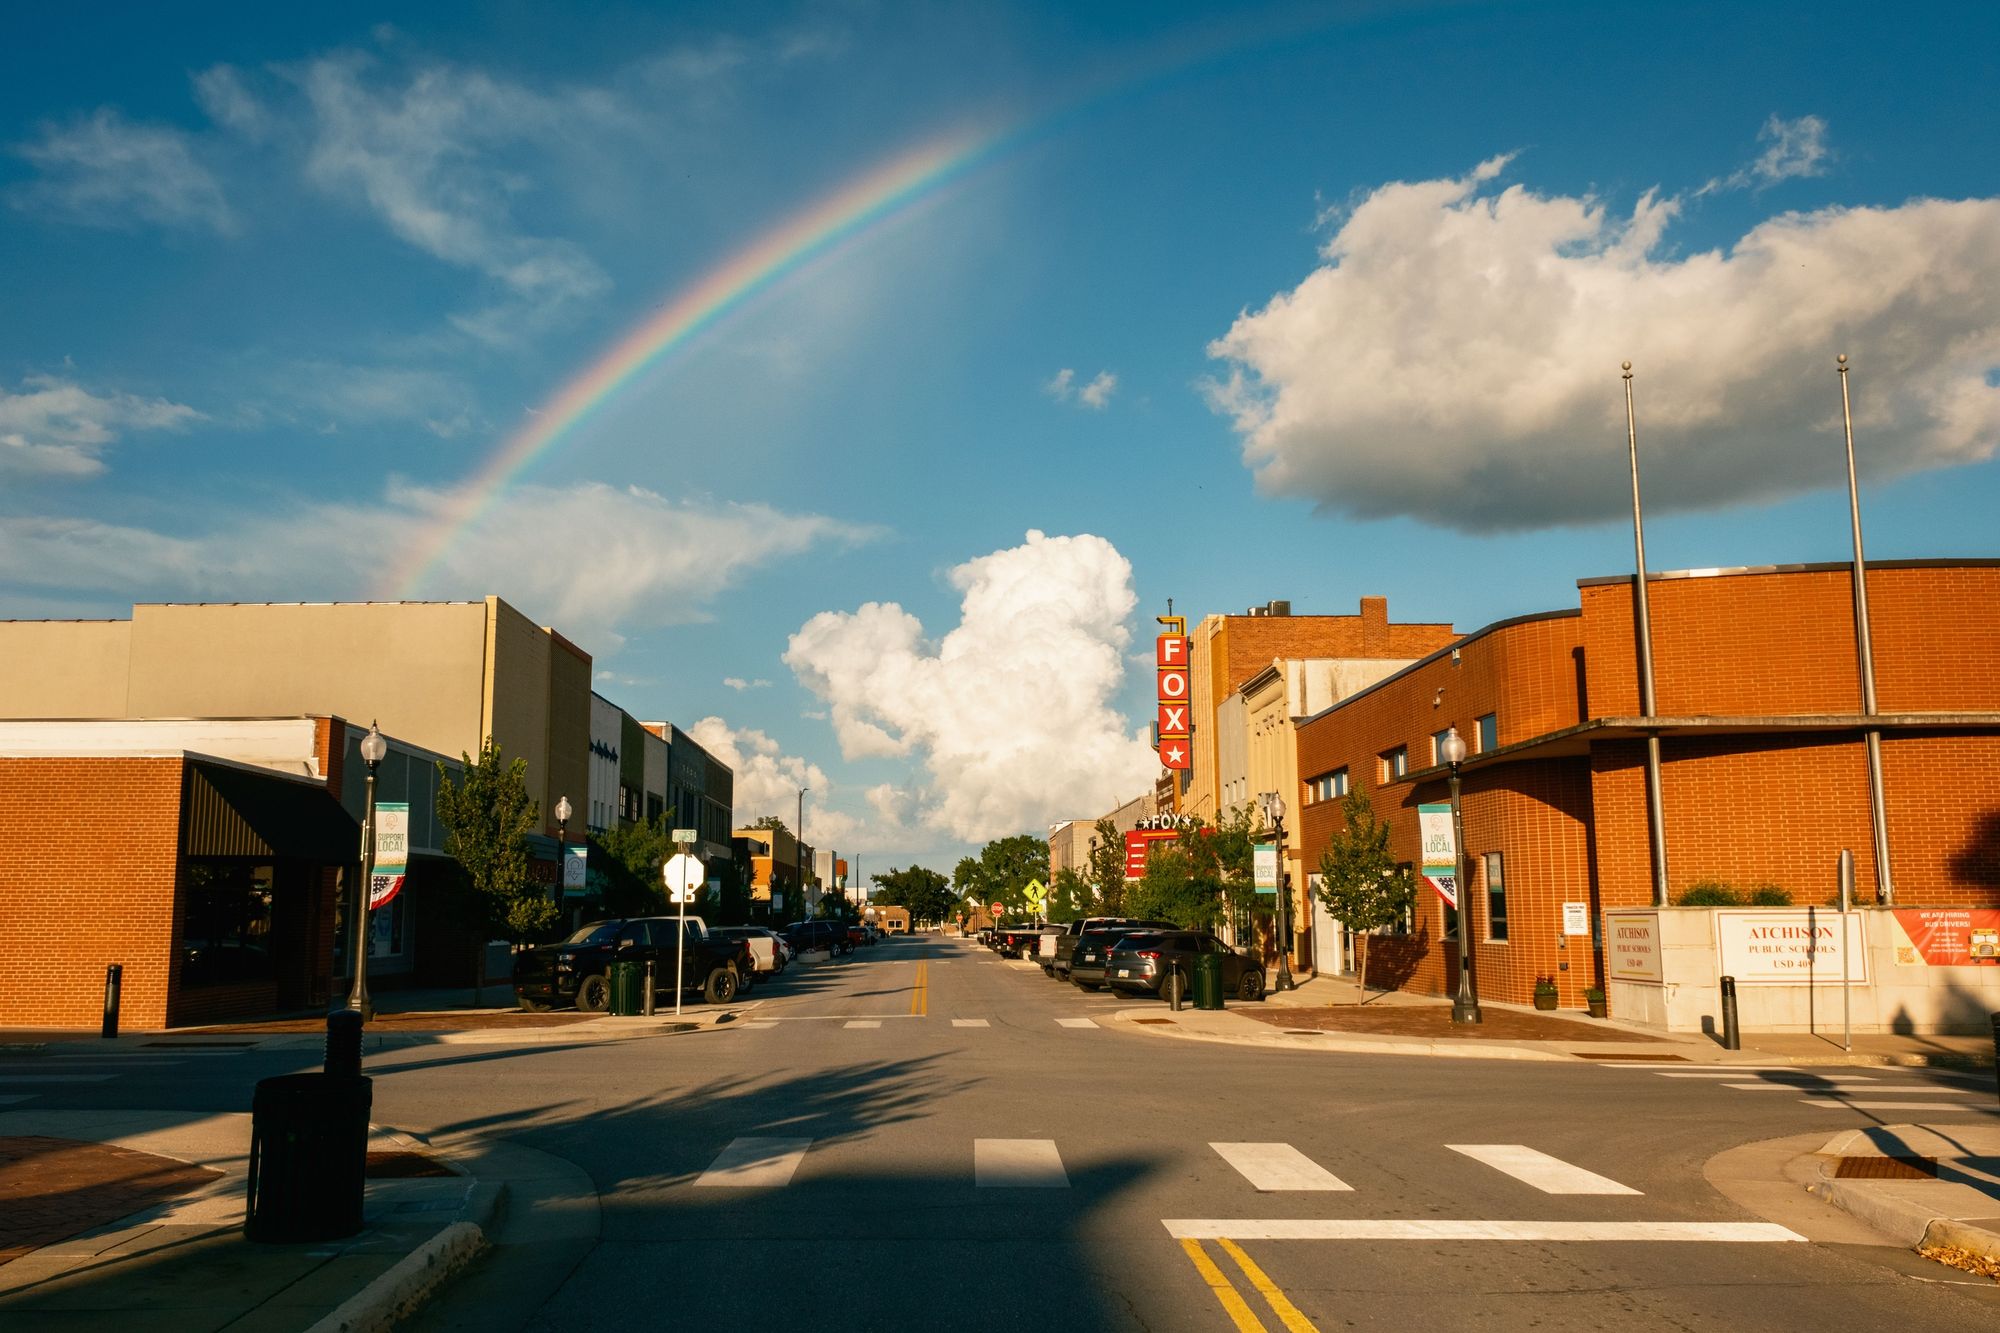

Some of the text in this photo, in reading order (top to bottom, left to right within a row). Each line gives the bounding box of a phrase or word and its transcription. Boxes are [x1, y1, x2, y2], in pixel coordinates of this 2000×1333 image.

[1162, 639, 1185, 732] FOX
[1152, 814, 1181, 829] FOX
[1430, 833, 1445, 841] LOVE
[377, 841, 404, 852] LOCAL
[1425, 842, 1452, 853] LOCAL
[1617, 927, 1650, 939] ATCHISON
[1749, 926, 1833, 939] ATCHISON
[1632, 945, 1652, 953] SCHOOLS
[1748, 945, 1836, 953] PUBLIC SCHOOLS
[1773, 959, 1814, 969] USD 409
